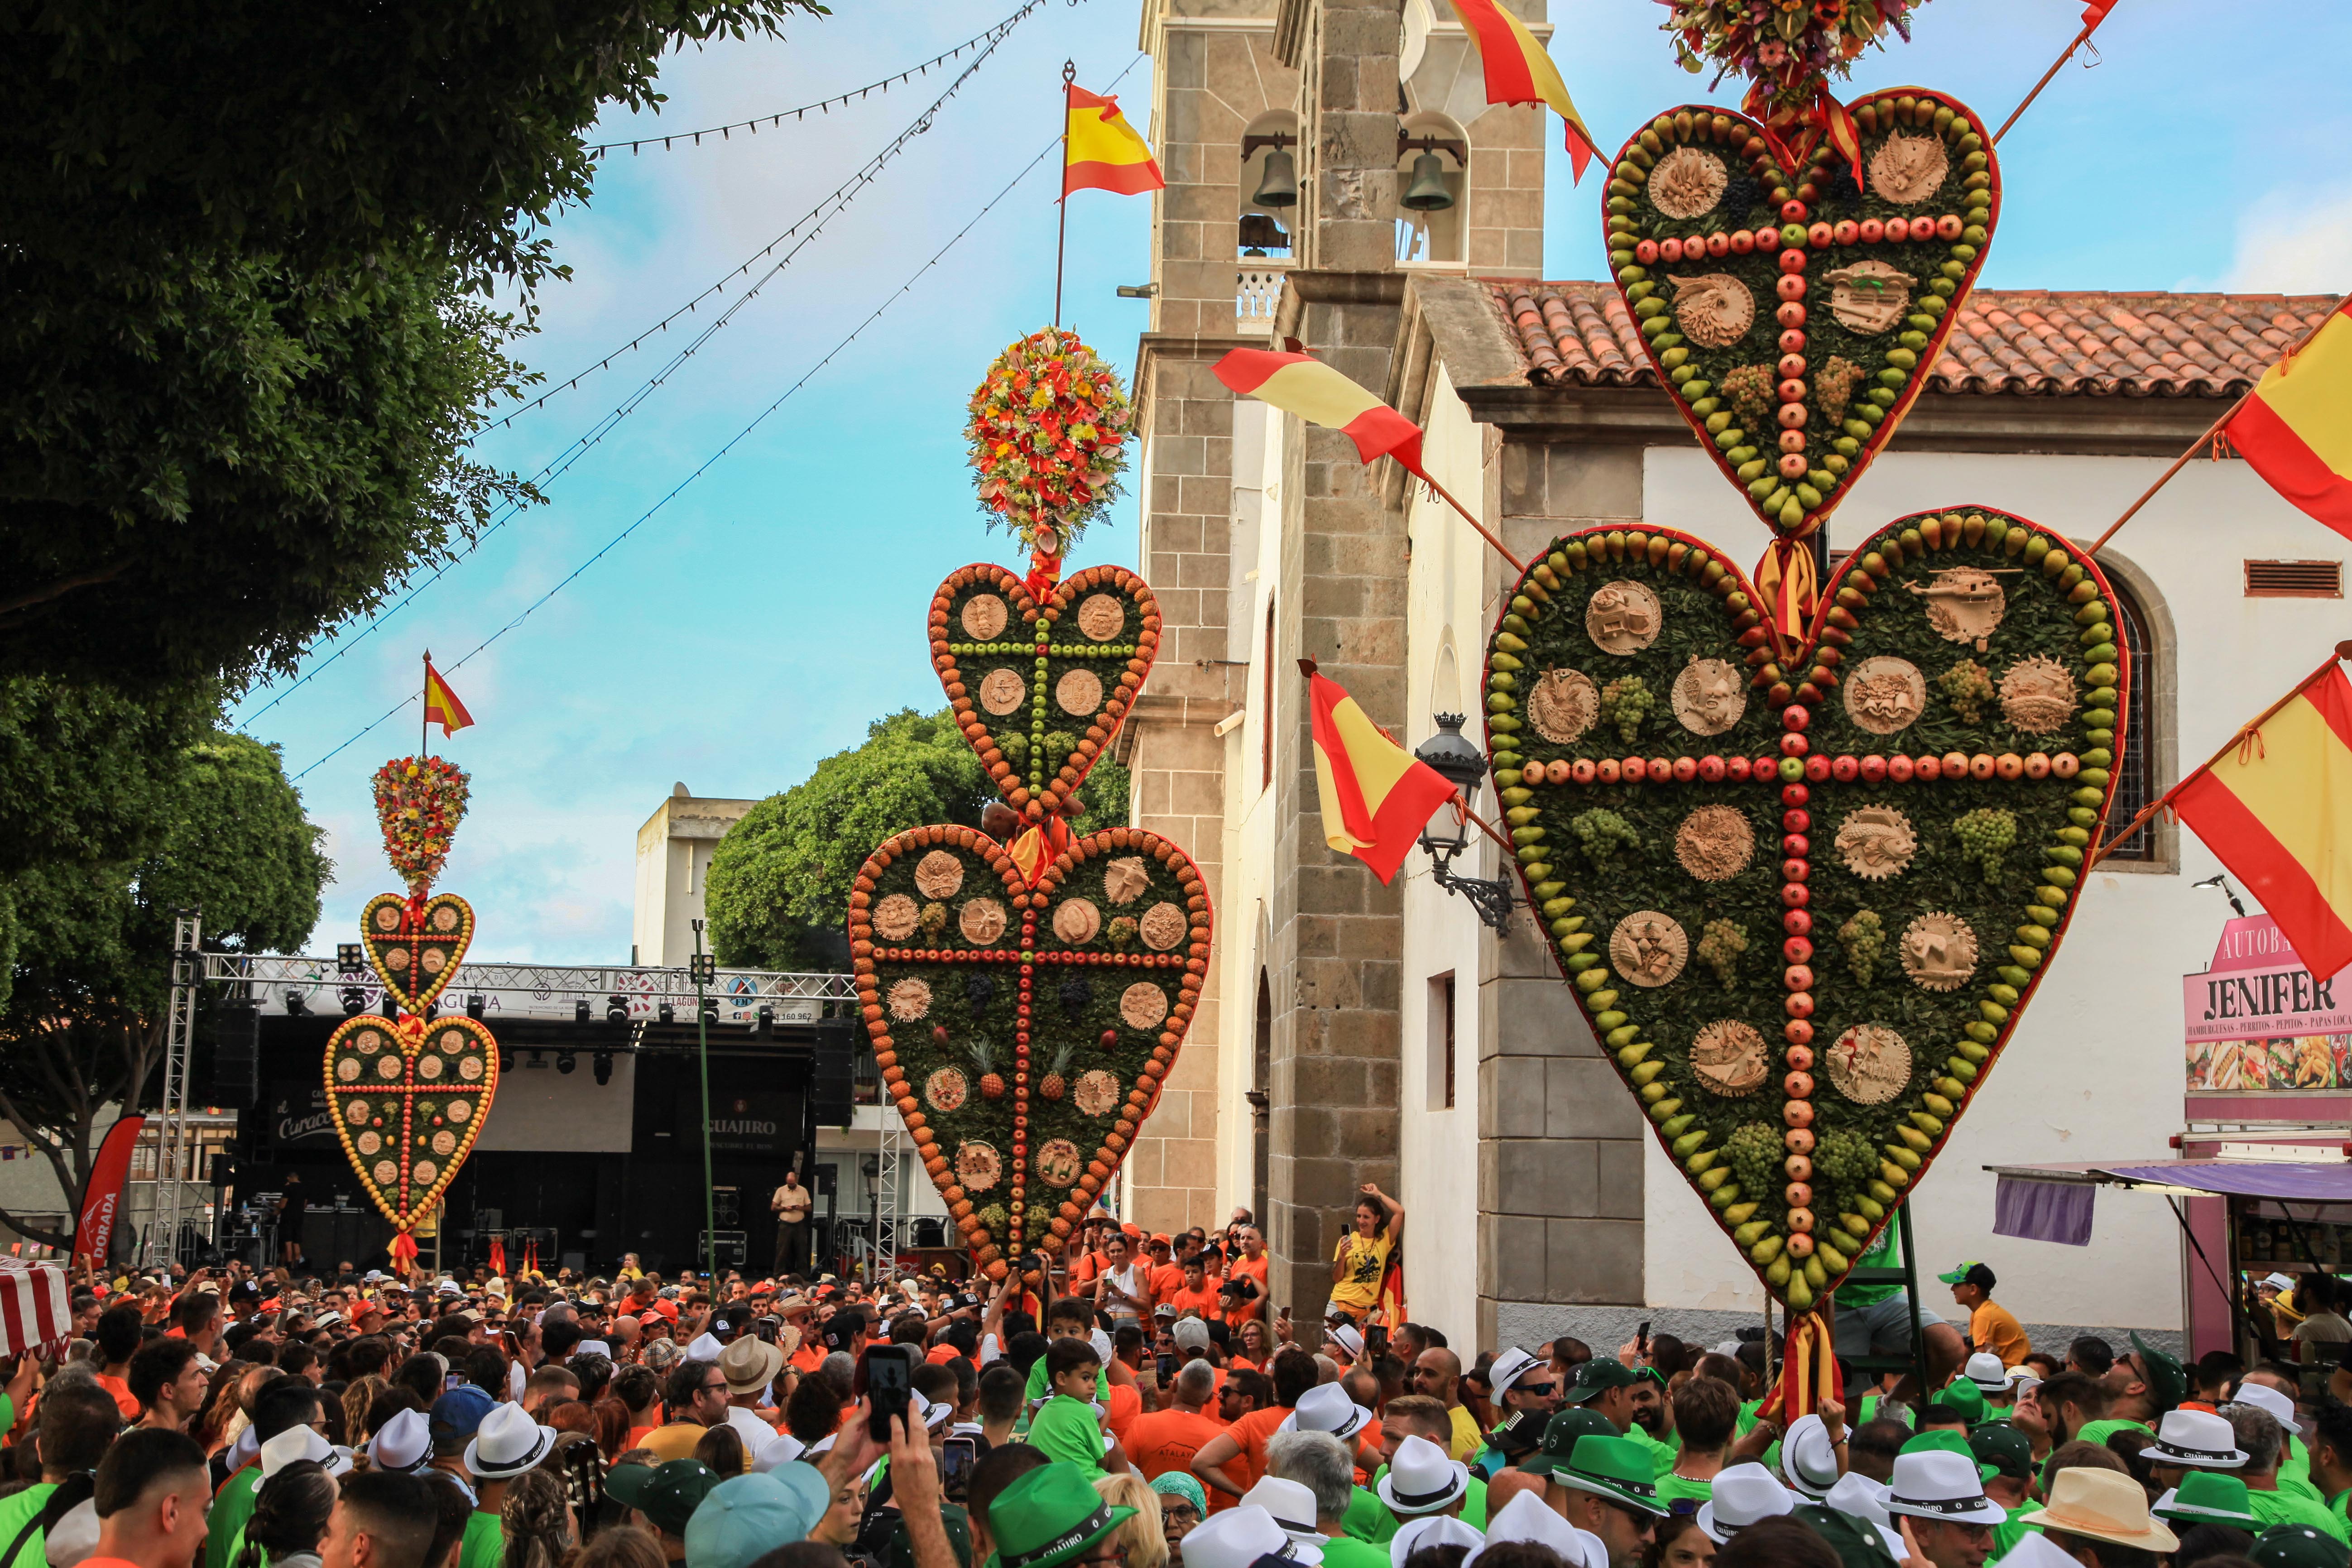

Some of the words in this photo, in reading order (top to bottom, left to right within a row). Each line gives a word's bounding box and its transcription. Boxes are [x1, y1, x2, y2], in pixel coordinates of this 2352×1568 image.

[672, 997, 699, 1007] LAGUN
[2204, 970, 2336, 1021] JENIFER
[2188, 1024, 2234, 1036] HAMBURGUESAS
[2240, 1021, 2270, 1033] PERRITOS
[2276, 1019, 2303, 1030] PEPITOS
[2310, 1016, 2332, 1028] PAPAS
[277, 1100, 289, 1114] el
[702, 1119, 777, 1135] GUAJIRO
[93, 1193, 117, 1259] DORADA
[1343, 1418, 1357, 1434] GUAJIRO
